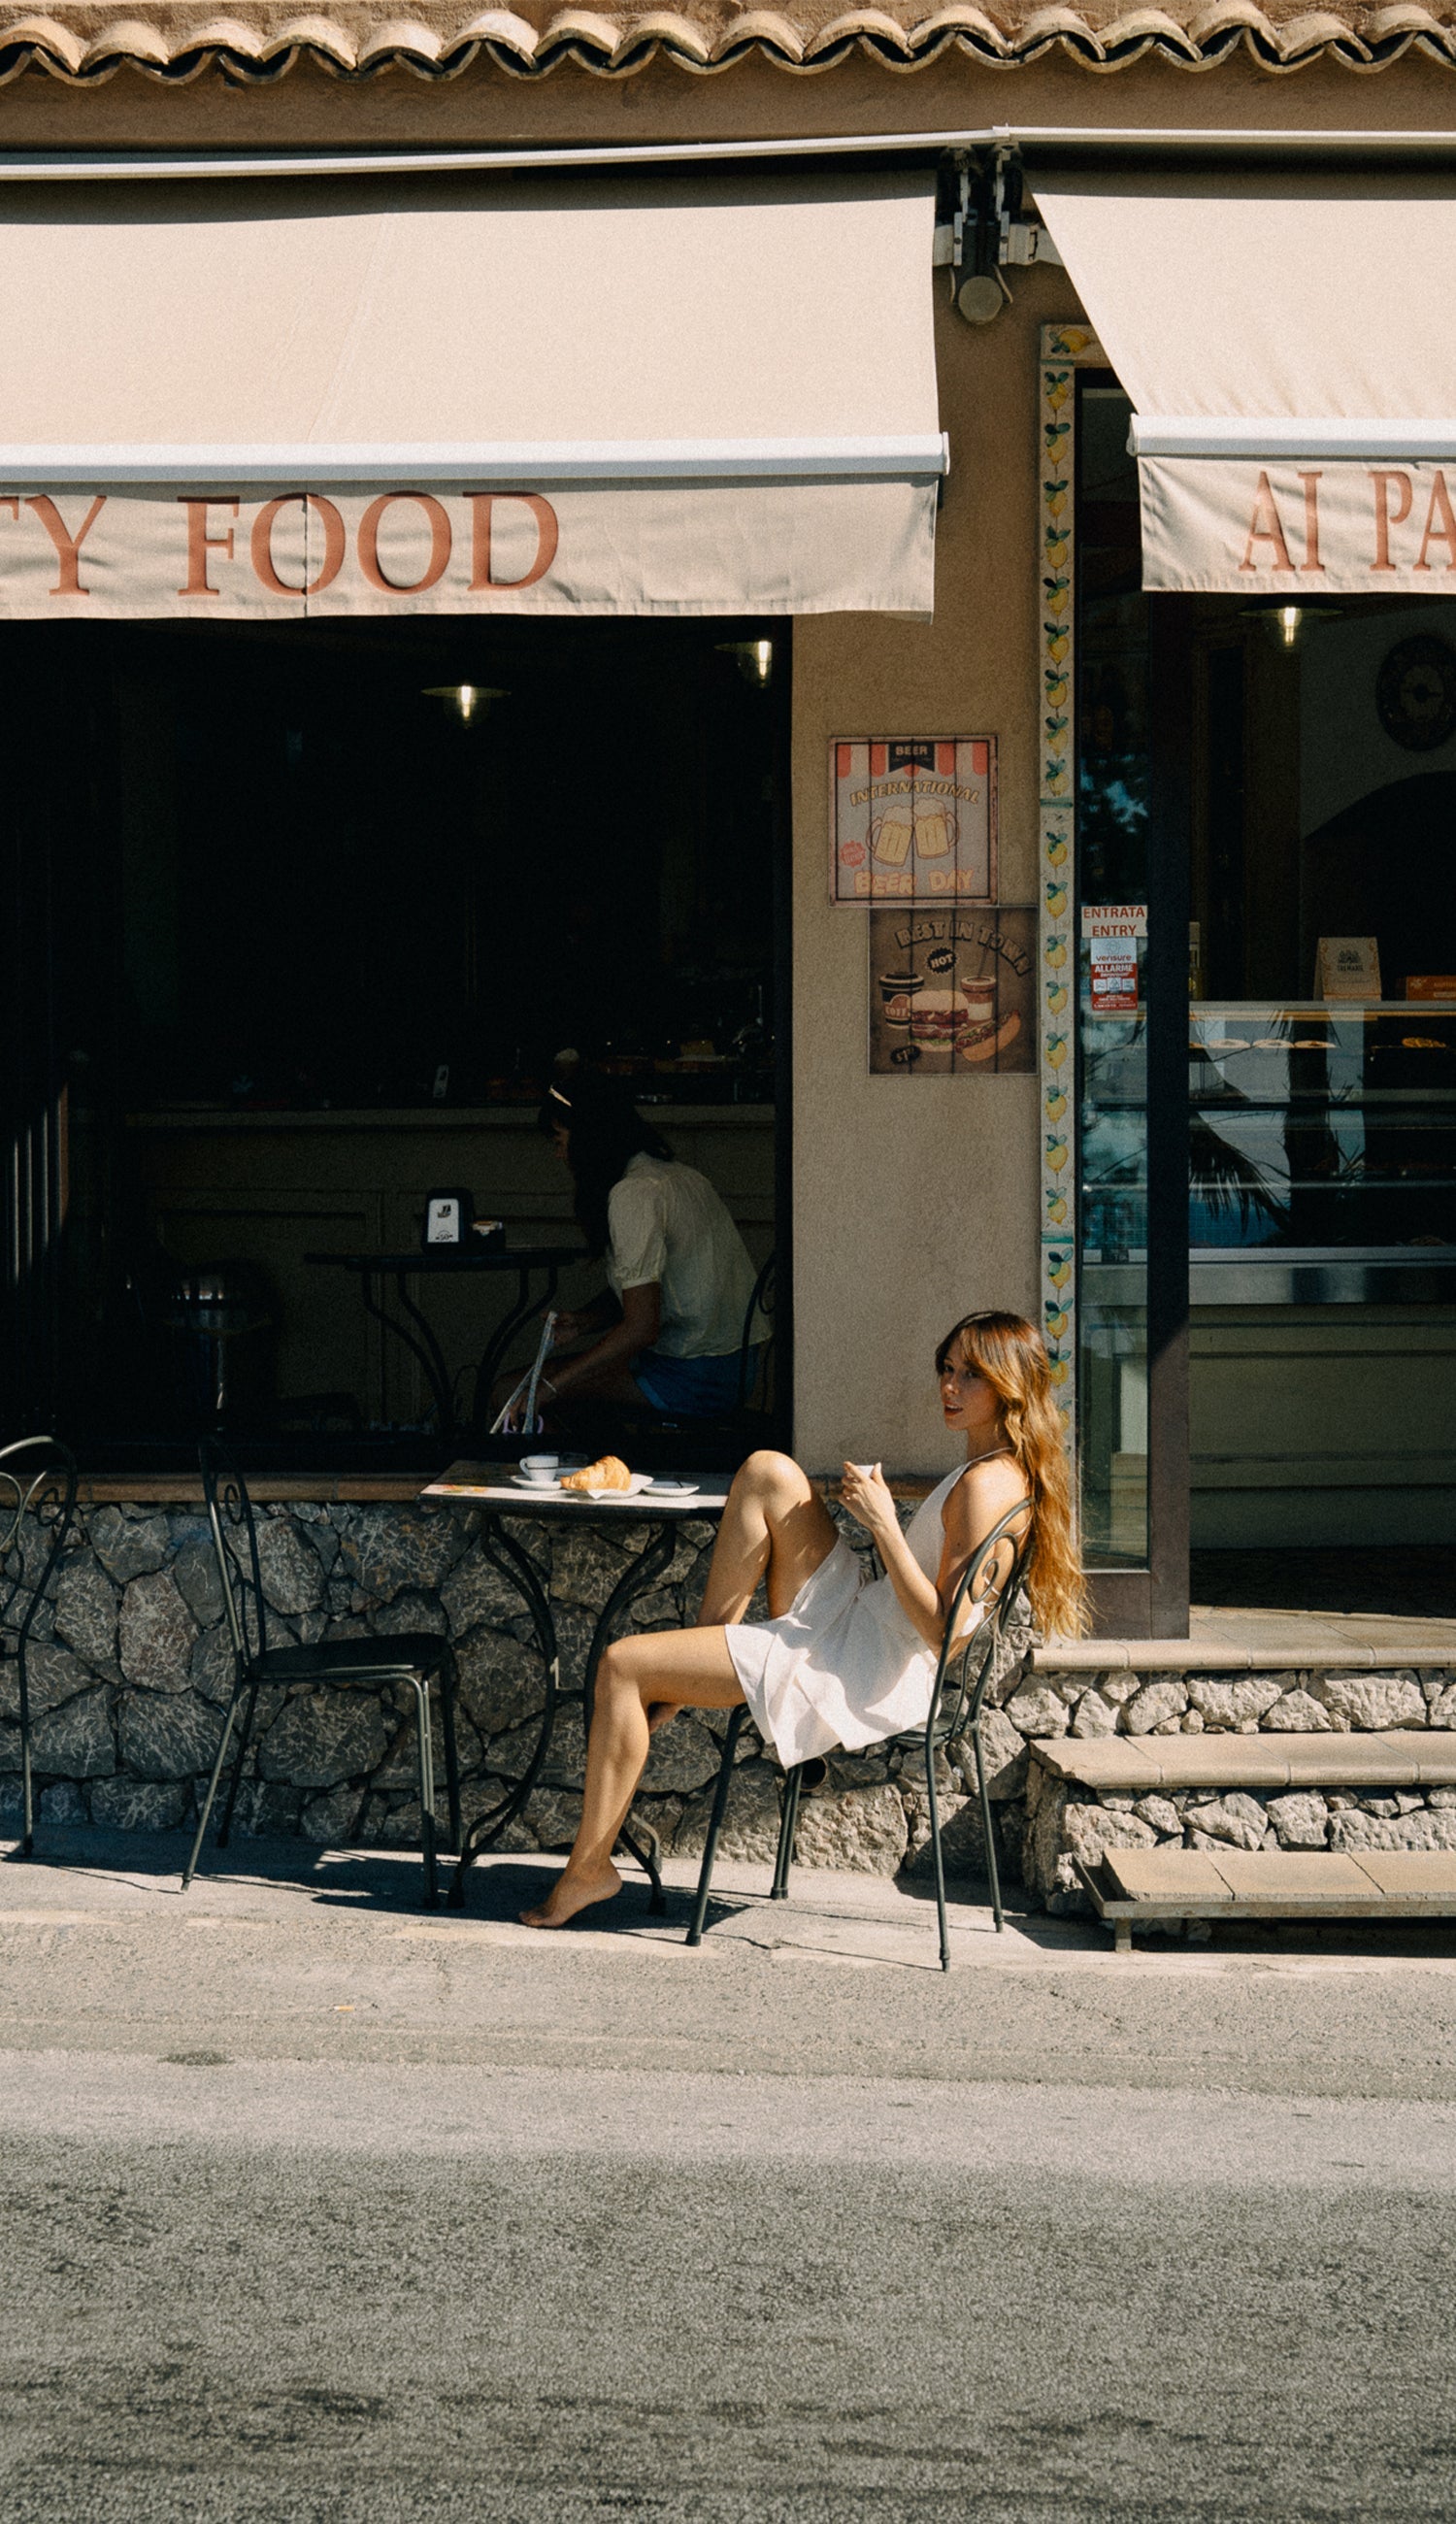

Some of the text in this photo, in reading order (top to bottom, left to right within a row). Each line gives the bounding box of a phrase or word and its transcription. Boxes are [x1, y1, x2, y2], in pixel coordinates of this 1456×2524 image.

[1238, 470, 1456, 572] AI PA
[0, 490, 559, 596] Y FOOD
[895, 745, 928, 756] BEER
[849, 780, 980, 807] INTERNATIONAL
[854, 869, 975, 895] BEER DAY
[1083, 907, 1145, 918] ENTRATA
[894, 921, 945, 948] BEST
[949, 920, 975, 942] IN
[1092, 925, 1137, 937] ENTRY
[930, 953, 954, 969] HOT
[1094, 963, 1134, 973] ALLARME
